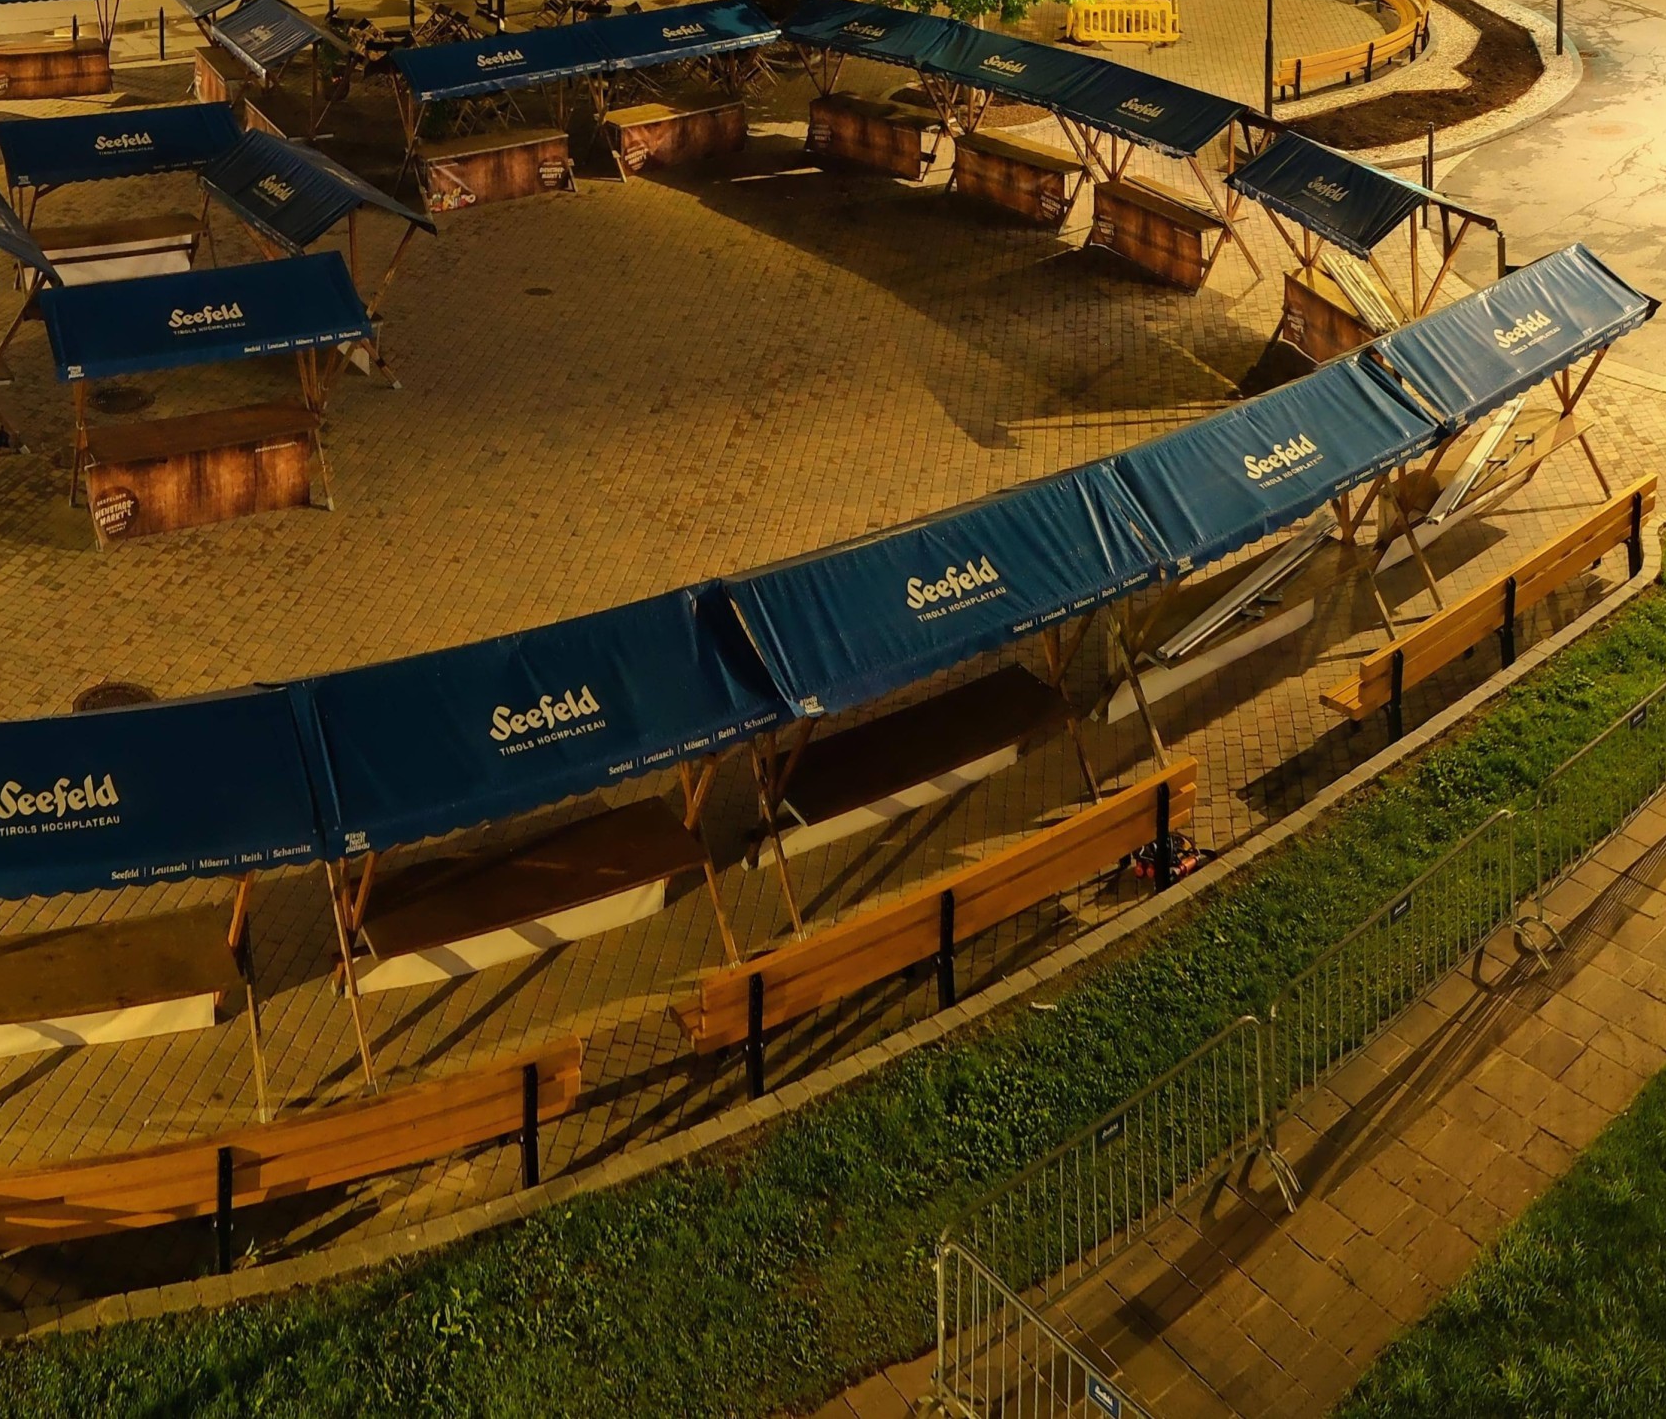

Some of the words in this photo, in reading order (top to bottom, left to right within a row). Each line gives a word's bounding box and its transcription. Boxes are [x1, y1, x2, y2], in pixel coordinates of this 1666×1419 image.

[662, 23, 705, 38] Seefeld
[477, 49, 524, 67] Seefeld
[983, 55, 1027, 73] Seefeld
[1121, 97, 1165, 118] Seefeld
[94, 132, 153, 150] Seefeld
[1307, 175, 1350, 203] Seefeld
[168, 302, 244, 329] Seefeld
[1494, 309, 1552, 349] Seefeld
[1244, 433, 1318, 480] Seefeld
[906, 555, 1000, 610] Seefeld
[916, 606, 948, 623] TIROLS
[948, 586, 1008, 613] HOCHPLATEAU
[489, 684, 601, 742] Seefeld
[498, 738, 535, 757] TIROLS
[537, 719, 607, 746] HOCHPLATEAU
[608, 758, 634, 776] Seefeld
[643, 748, 675, 765] Leutasch
[683, 737, 710, 752] Mösern
[717, 726, 737, 741] Reith
[744, 711, 778, 731] Scharnitz
[41, 814, 121, 833] HOCHPLATEAU
[111, 868, 140, 880] Seefeld
[151, 862, 187, 875] Leutasch
[199, 858, 230, 869] Mösern
[241, 852, 263, 864] Reith
[273, 844, 312, 859] Scharnitz
